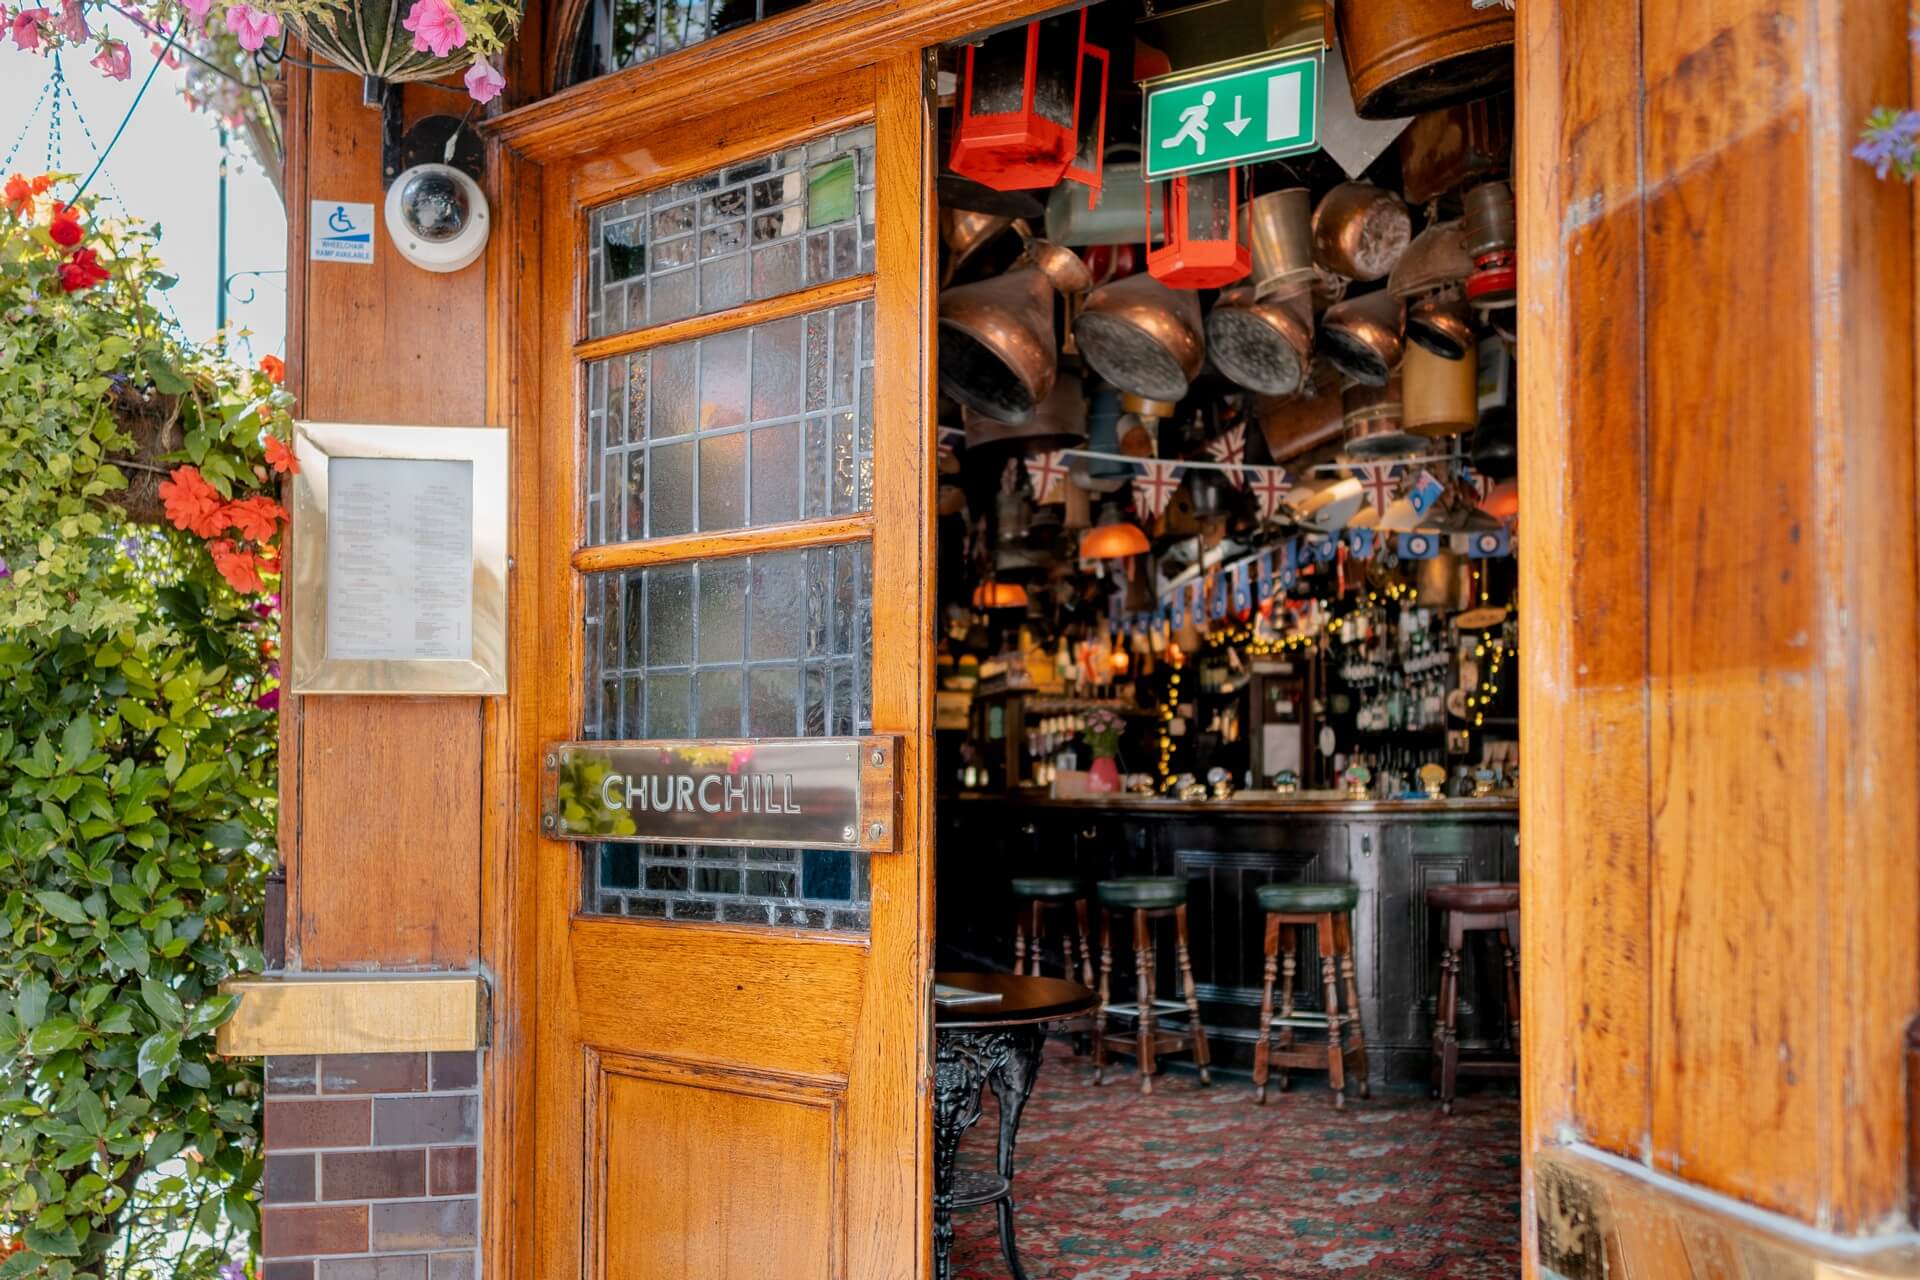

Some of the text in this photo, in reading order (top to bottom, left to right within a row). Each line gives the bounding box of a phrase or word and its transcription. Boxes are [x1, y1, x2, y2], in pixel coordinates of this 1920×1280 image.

[321, 240, 365, 249] WHEELCHAIR
[335, 250, 369, 259] AVAILABLE
[602, 774, 801, 814] CHURCHILL
